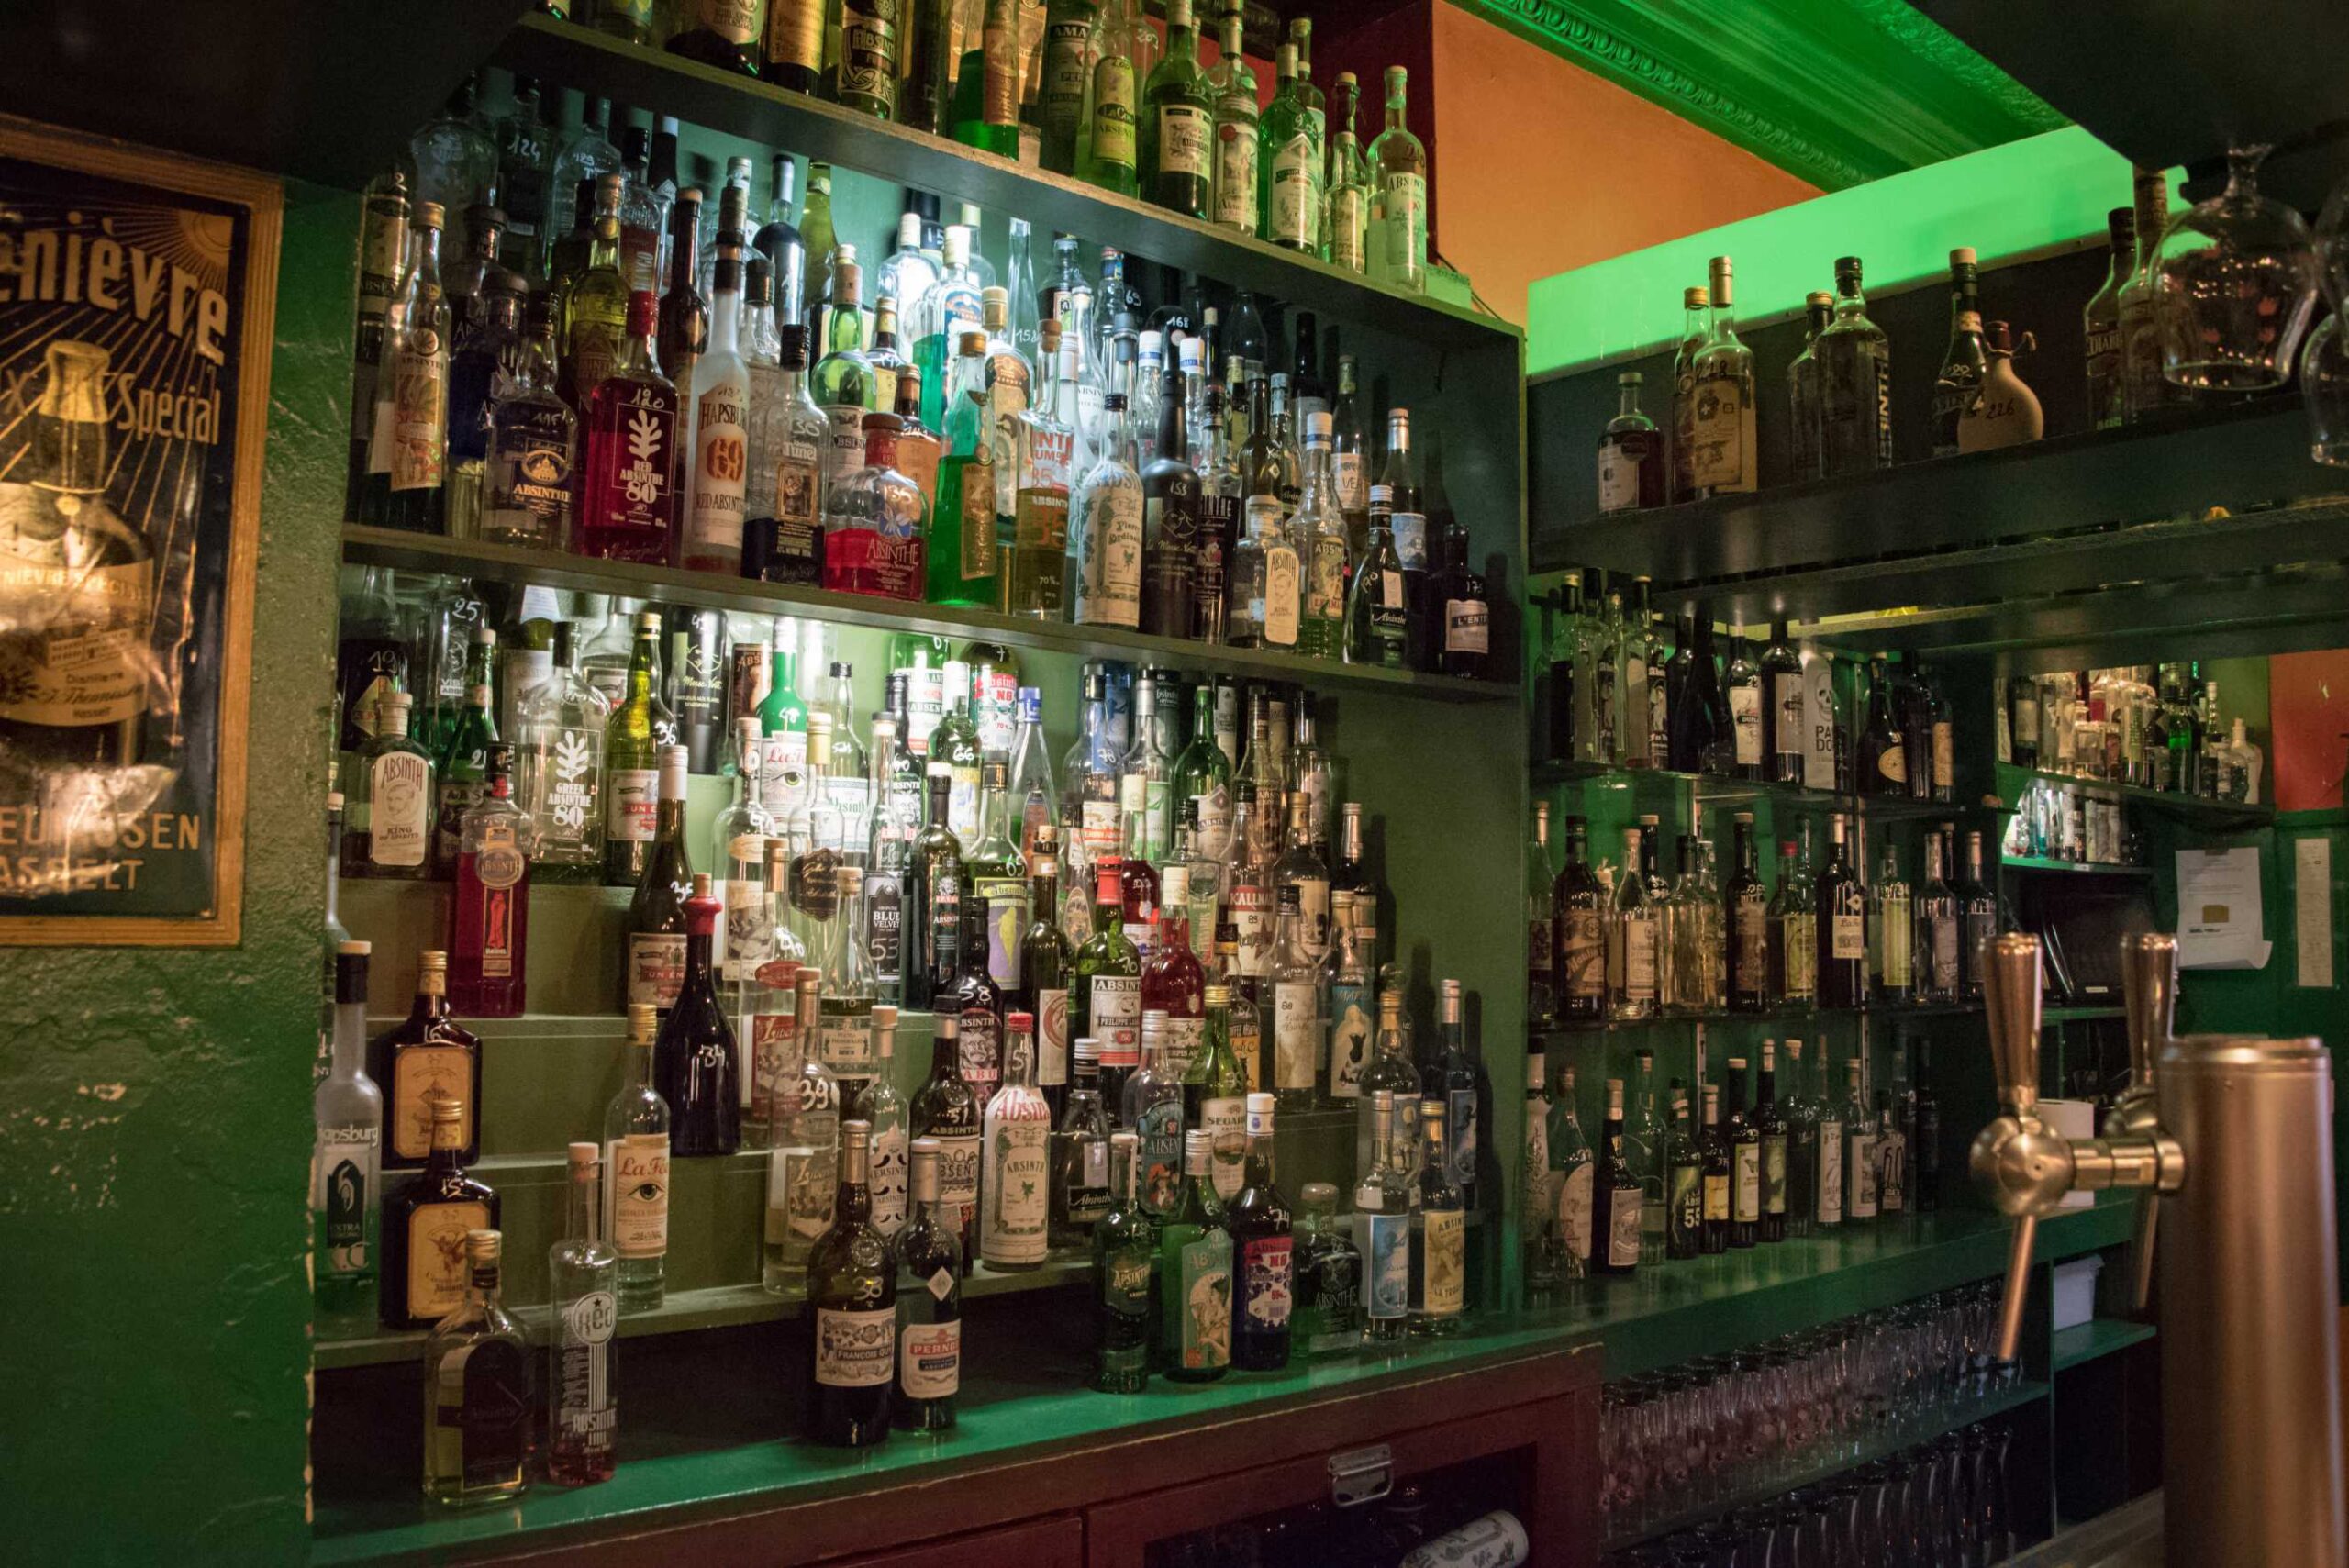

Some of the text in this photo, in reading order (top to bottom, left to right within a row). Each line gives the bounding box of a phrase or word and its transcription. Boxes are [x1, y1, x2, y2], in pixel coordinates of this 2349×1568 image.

[0, 212, 228, 366] nièvre
[117, 372, 220, 447] Spécial
[633, 460, 652, 472] RED
[620, 469, 664, 484] ABSINTHE
[513, 484, 572, 502] ABSINTHE
[625, 481, 658, 505] 80
[451, 597, 481, 621] 25
[380, 758, 423, 791] ABSINTH
[555, 783, 585, 795] GREEN
[548, 794, 592, 808] ABSINTHE
[552, 806, 584, 827] 80
[873, 910, 900, 922] BLUE
[871, 937, 900, 962] 53
[957, 984, 993, 1001] 58
